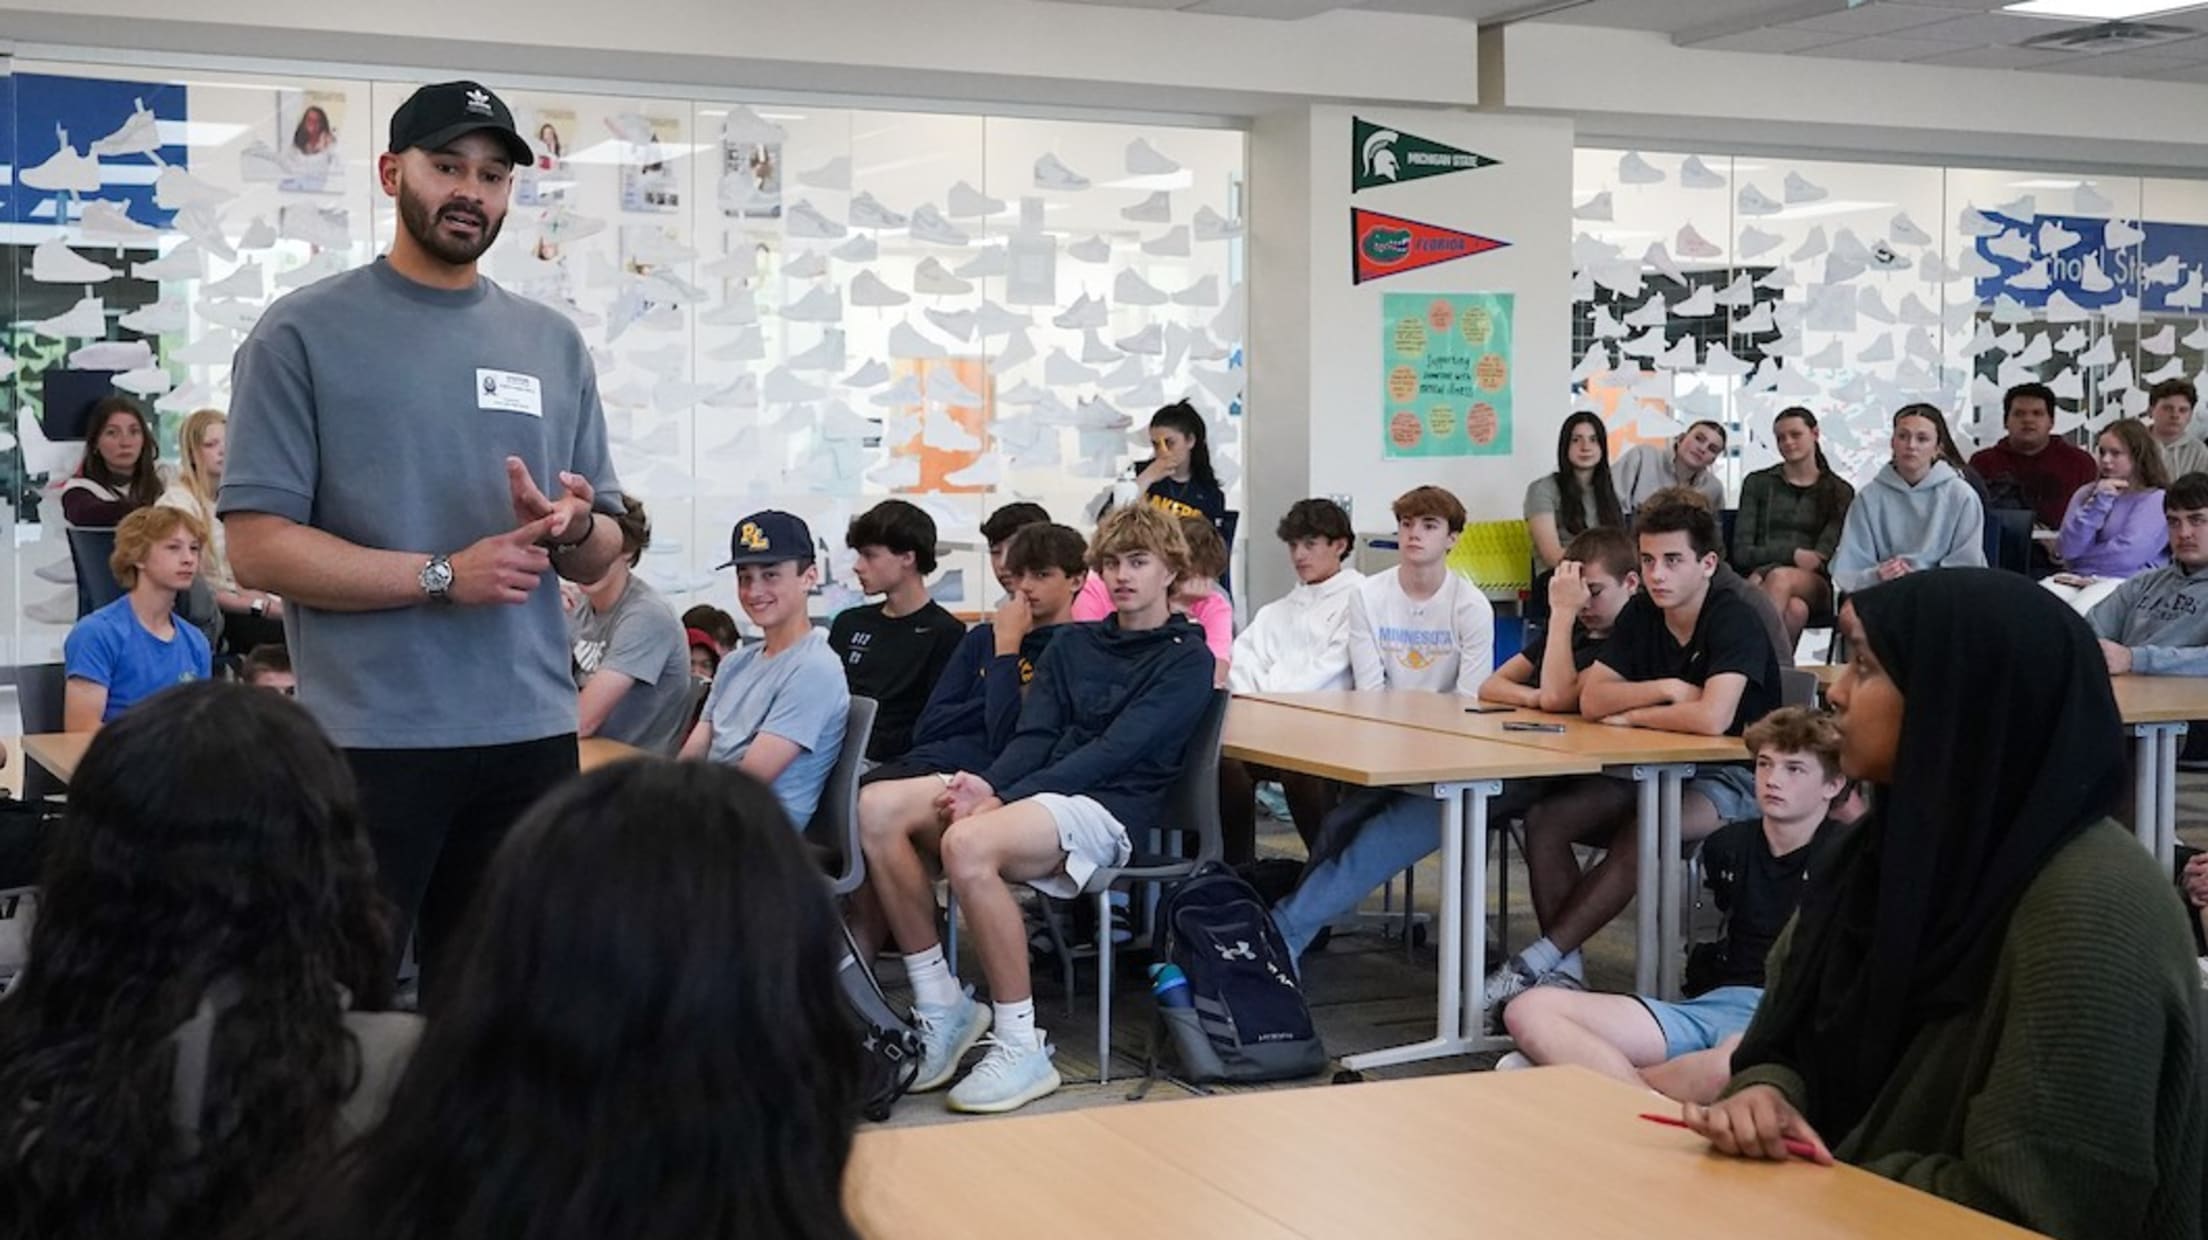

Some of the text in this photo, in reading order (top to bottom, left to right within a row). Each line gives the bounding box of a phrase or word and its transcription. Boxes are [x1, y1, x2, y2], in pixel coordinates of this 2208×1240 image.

[1407, 151, 1478, 167] MICHIGAN STATE
[1414, 237, 1465, 251] FLORIDA
[1147, 492, 1202, 517] AKERS
[1379, 627, 1453, 646] MINNESOTA
